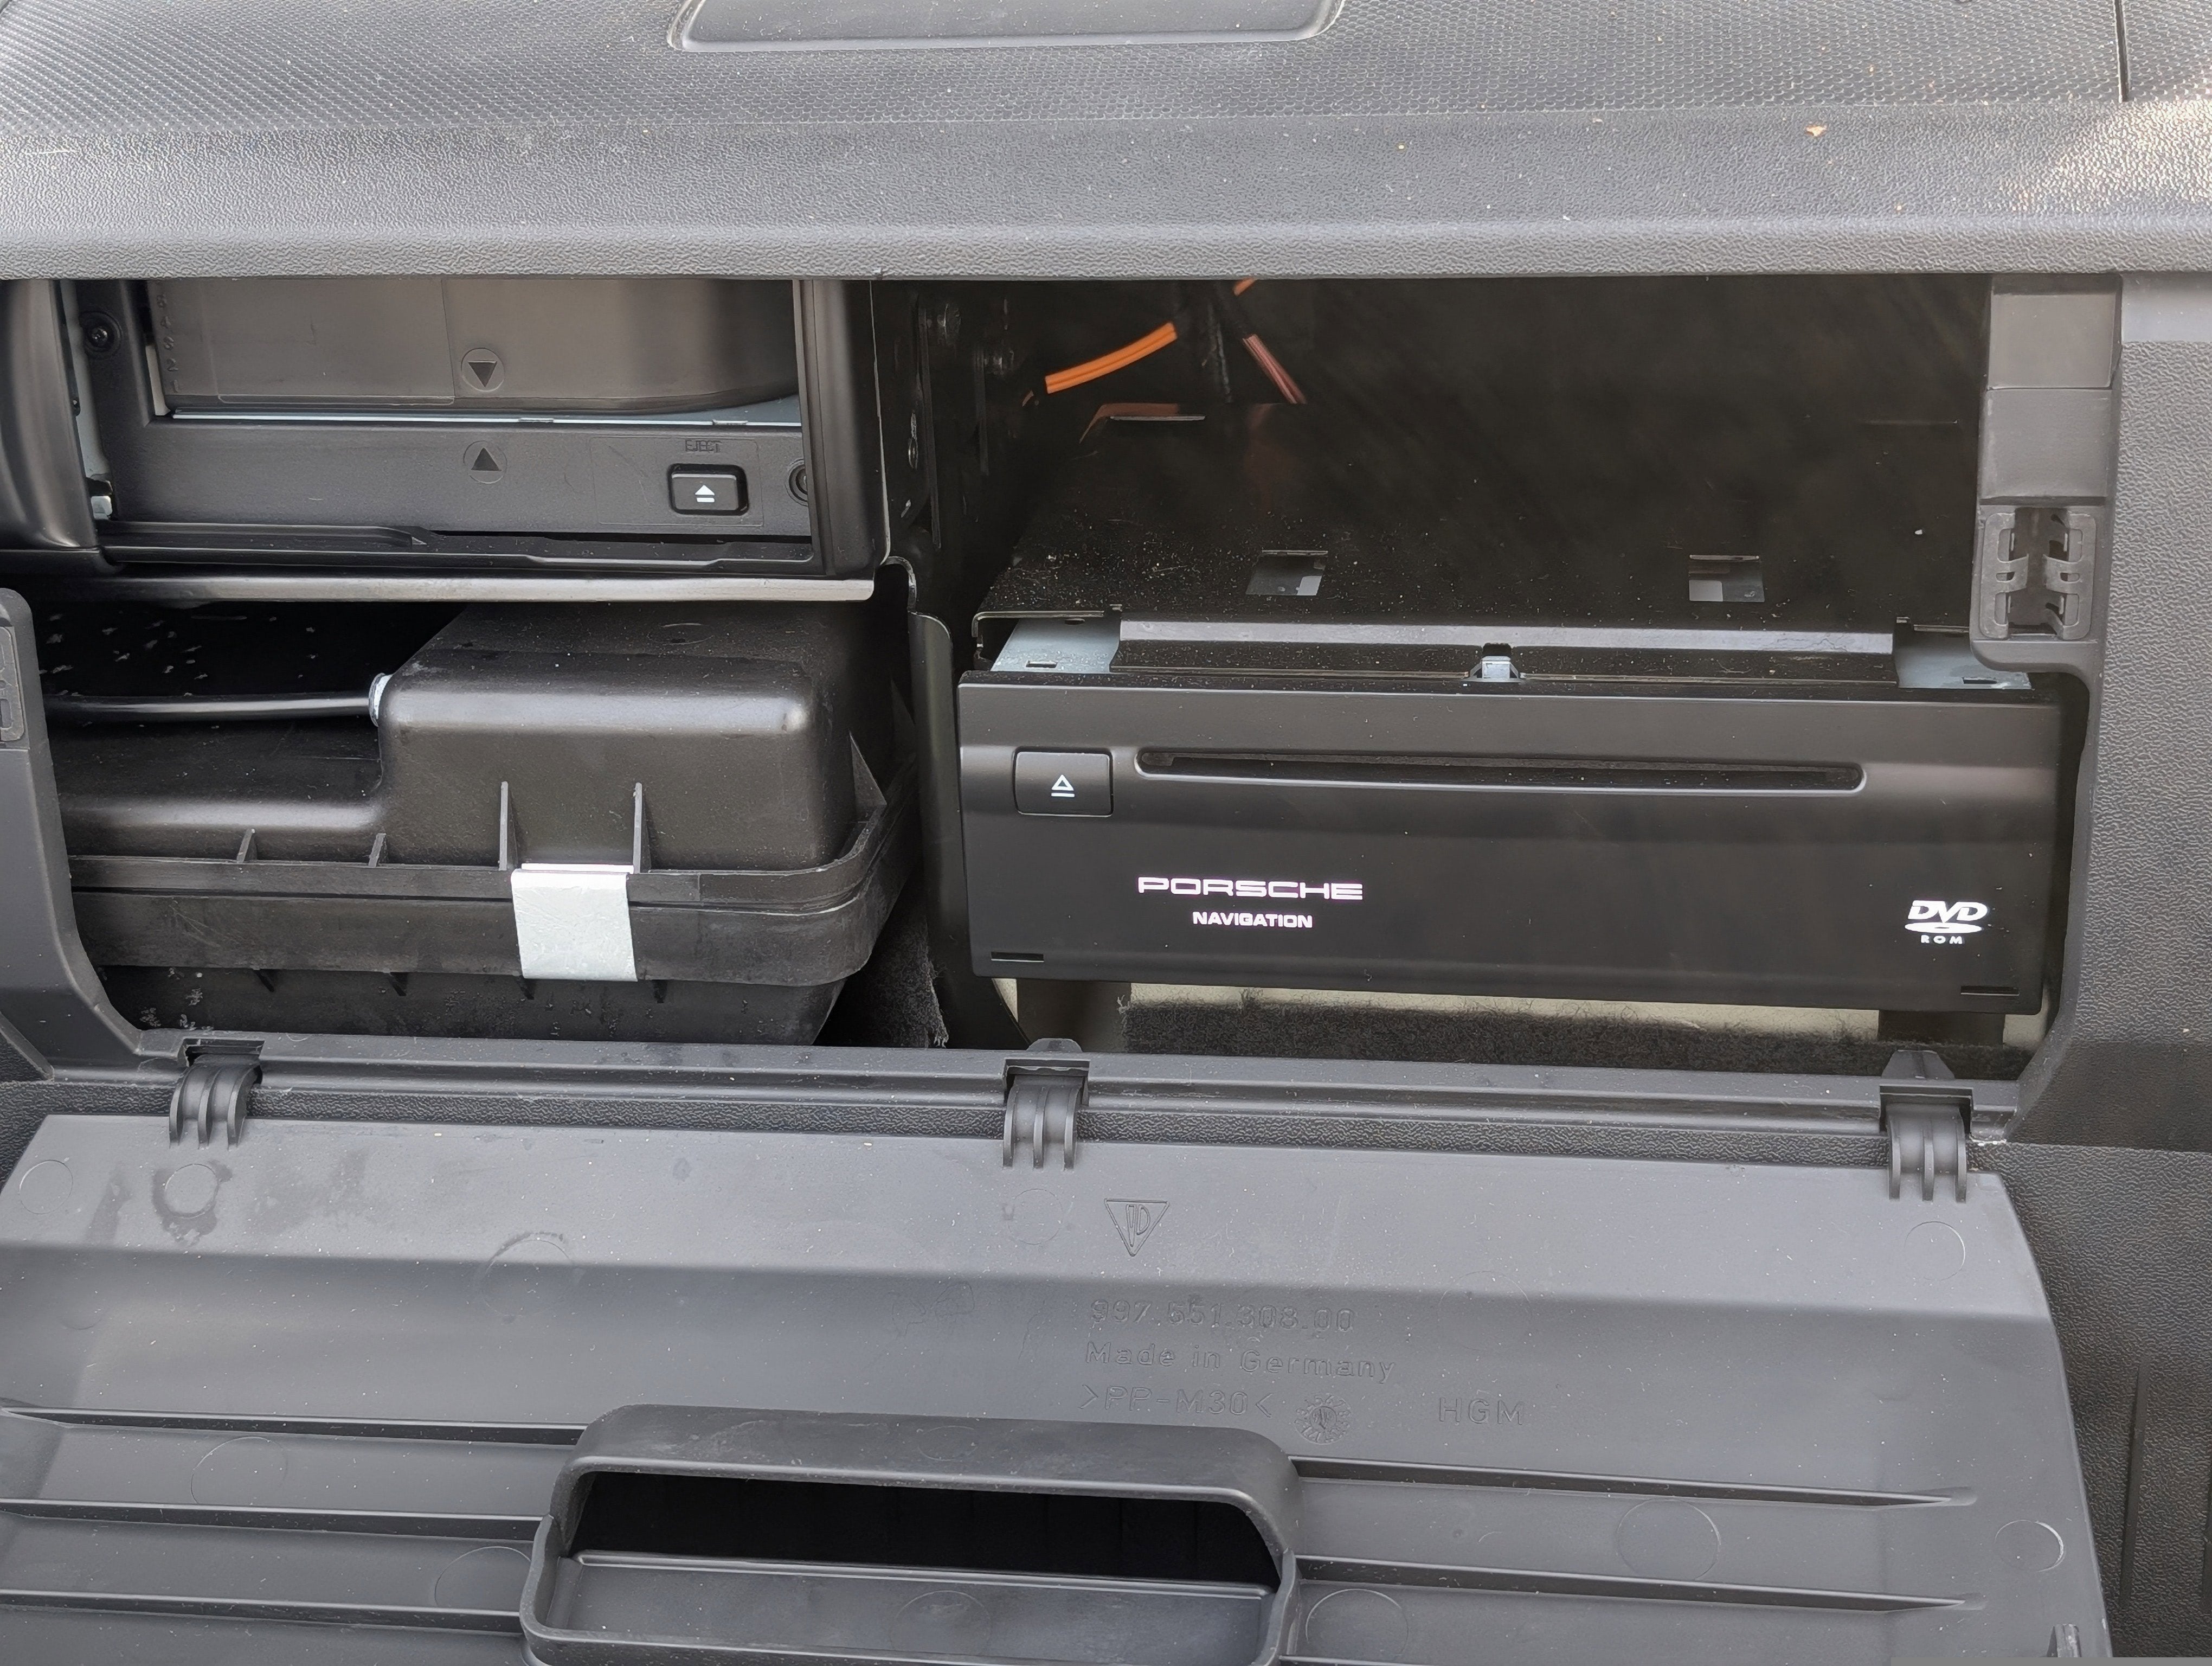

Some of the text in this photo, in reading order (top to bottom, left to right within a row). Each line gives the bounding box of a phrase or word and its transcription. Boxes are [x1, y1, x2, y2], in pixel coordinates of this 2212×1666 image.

[167, 358, 179, 372] 2
[685, 440, 722, 453] EJECT
[1138, 876, 1363, 900] PORSCHE
[1192, 911, 1313, 928] NAVIGATION
[1907, 900, 1988, 923] DVD
[1920, 934, 1963, 945] ROM
[1086, 1341, 1396, 1385] Made in Germany
[1439, 1396, 1525, 1426] HGM
